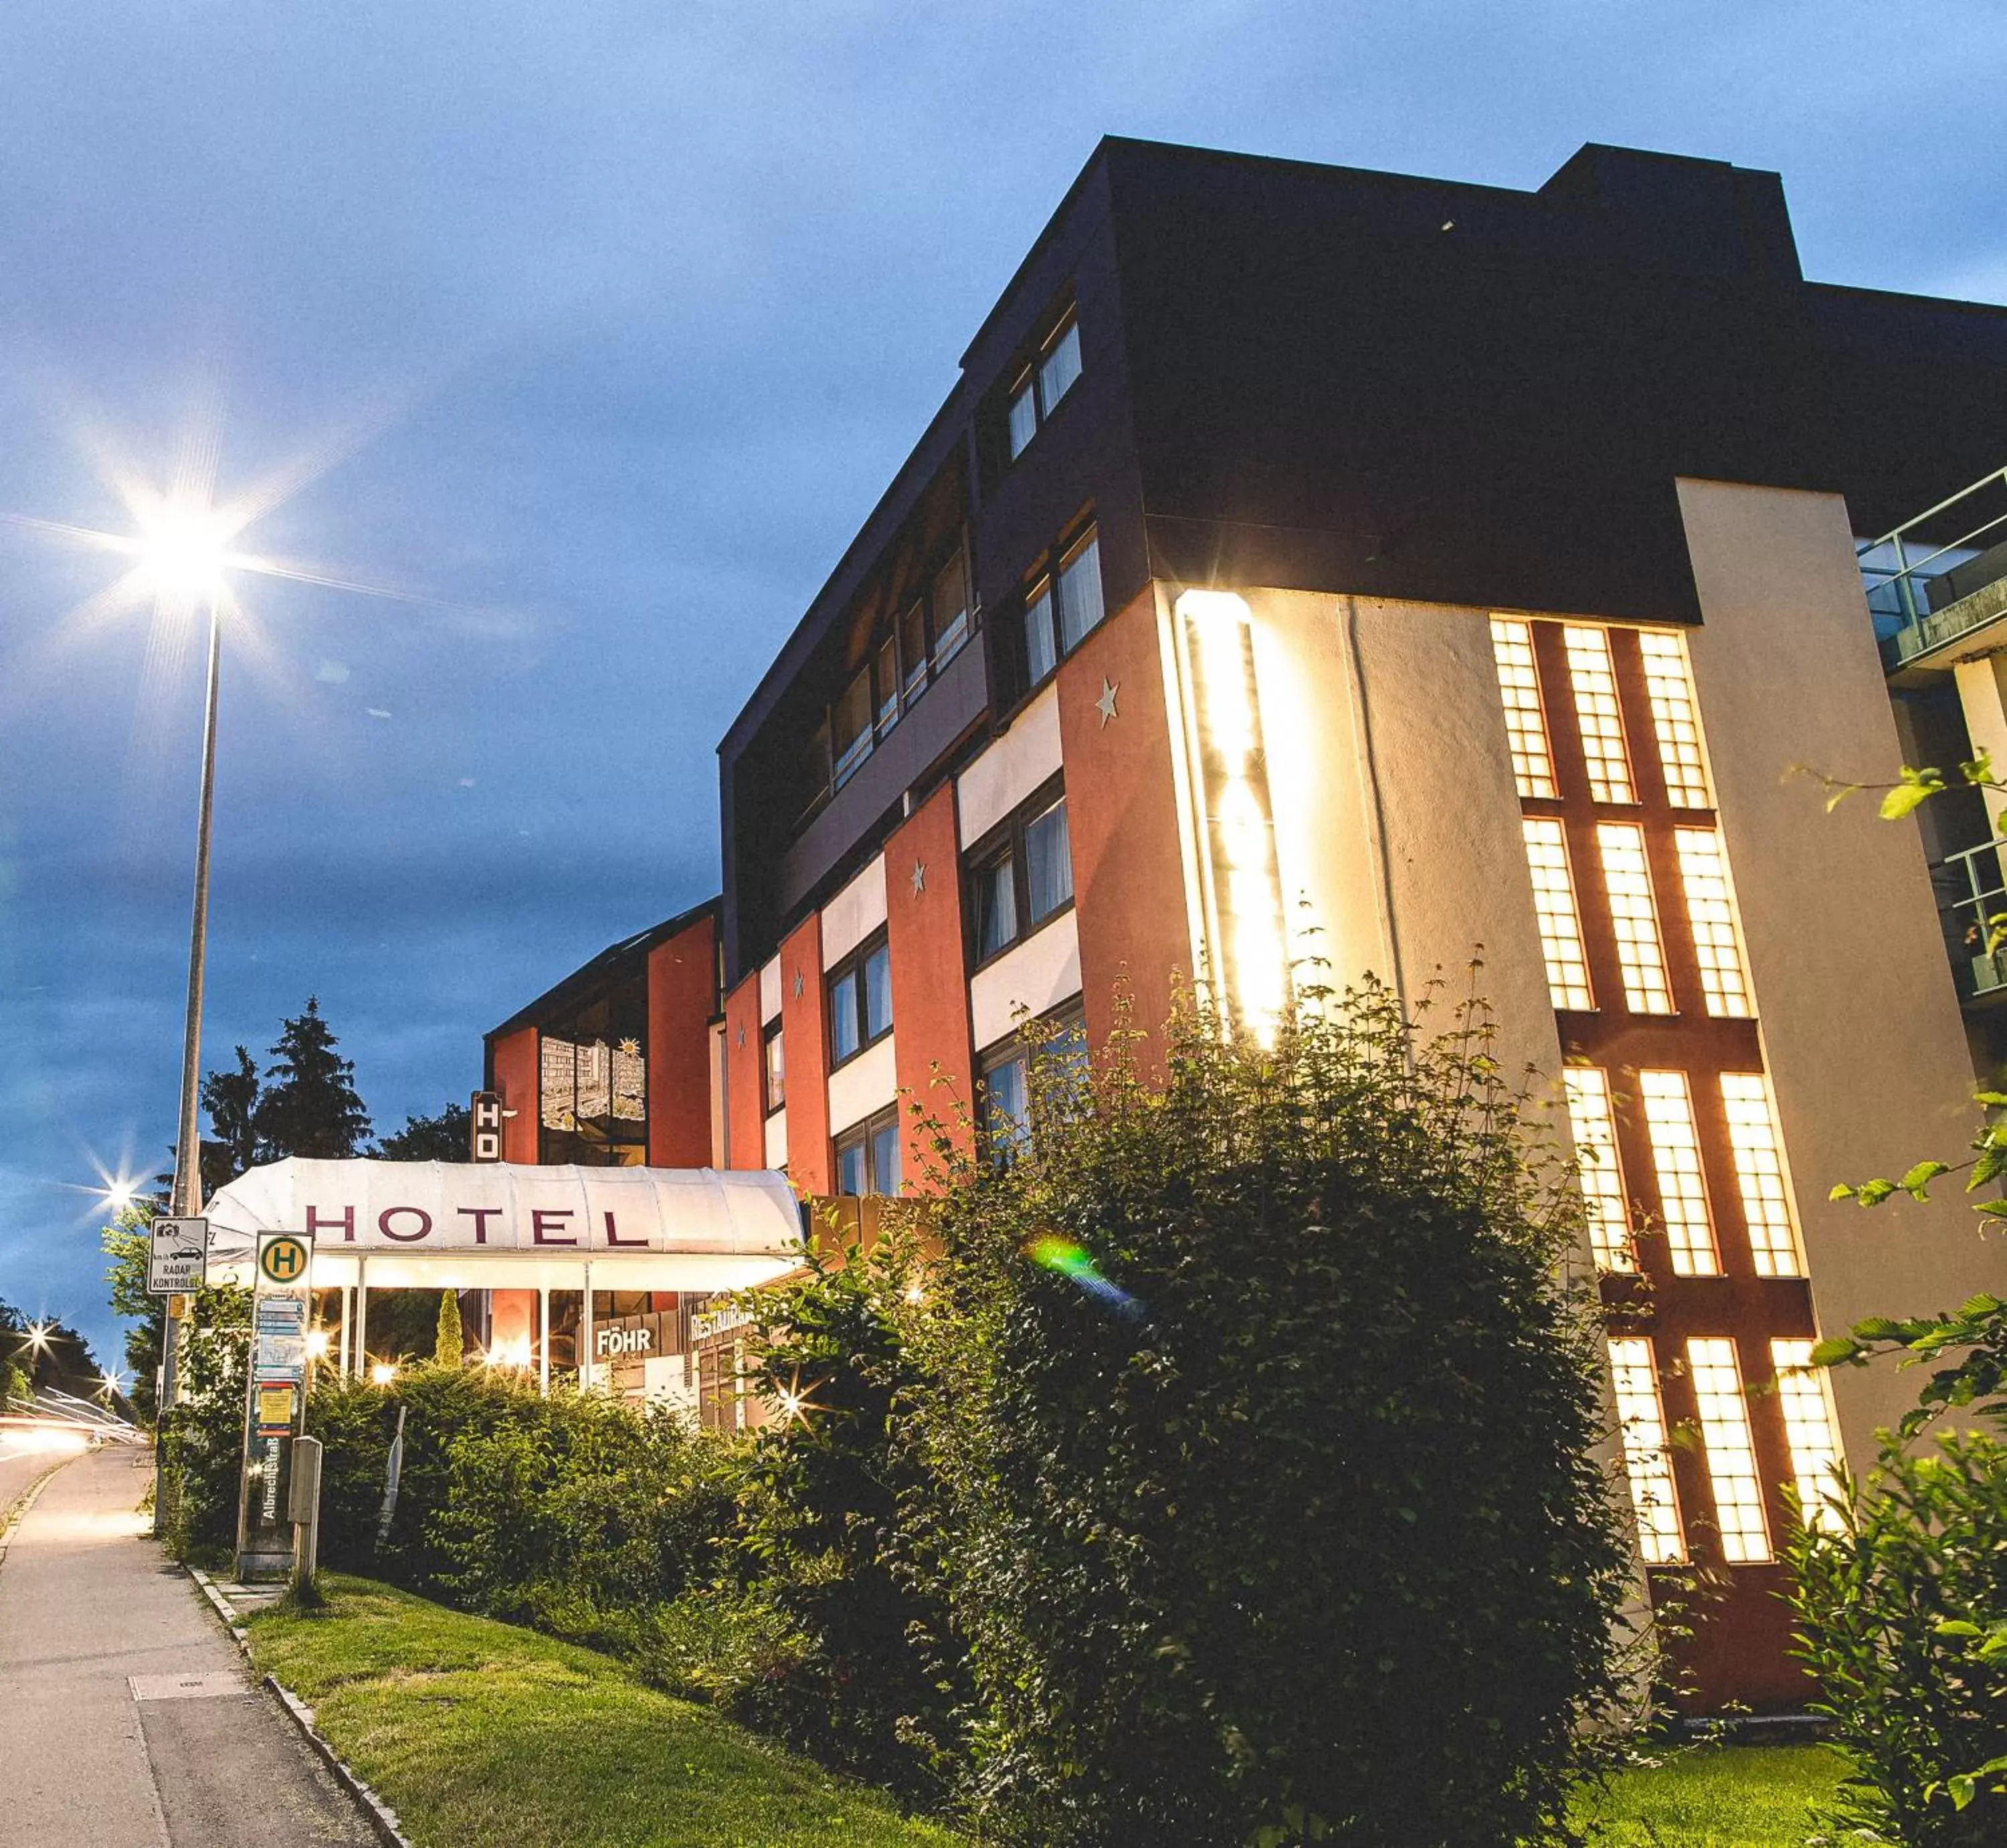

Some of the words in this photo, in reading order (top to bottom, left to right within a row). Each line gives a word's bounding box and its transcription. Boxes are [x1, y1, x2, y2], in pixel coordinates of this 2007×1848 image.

[477, 1103, 498, 1158] HO
[306, 1205, 650, 1247] HOTEL
[163, 1265, 191, 1275] RADAR
[273, 1247, 296, 1273] H
[597, 1325, 652, 1356] FÖHR
